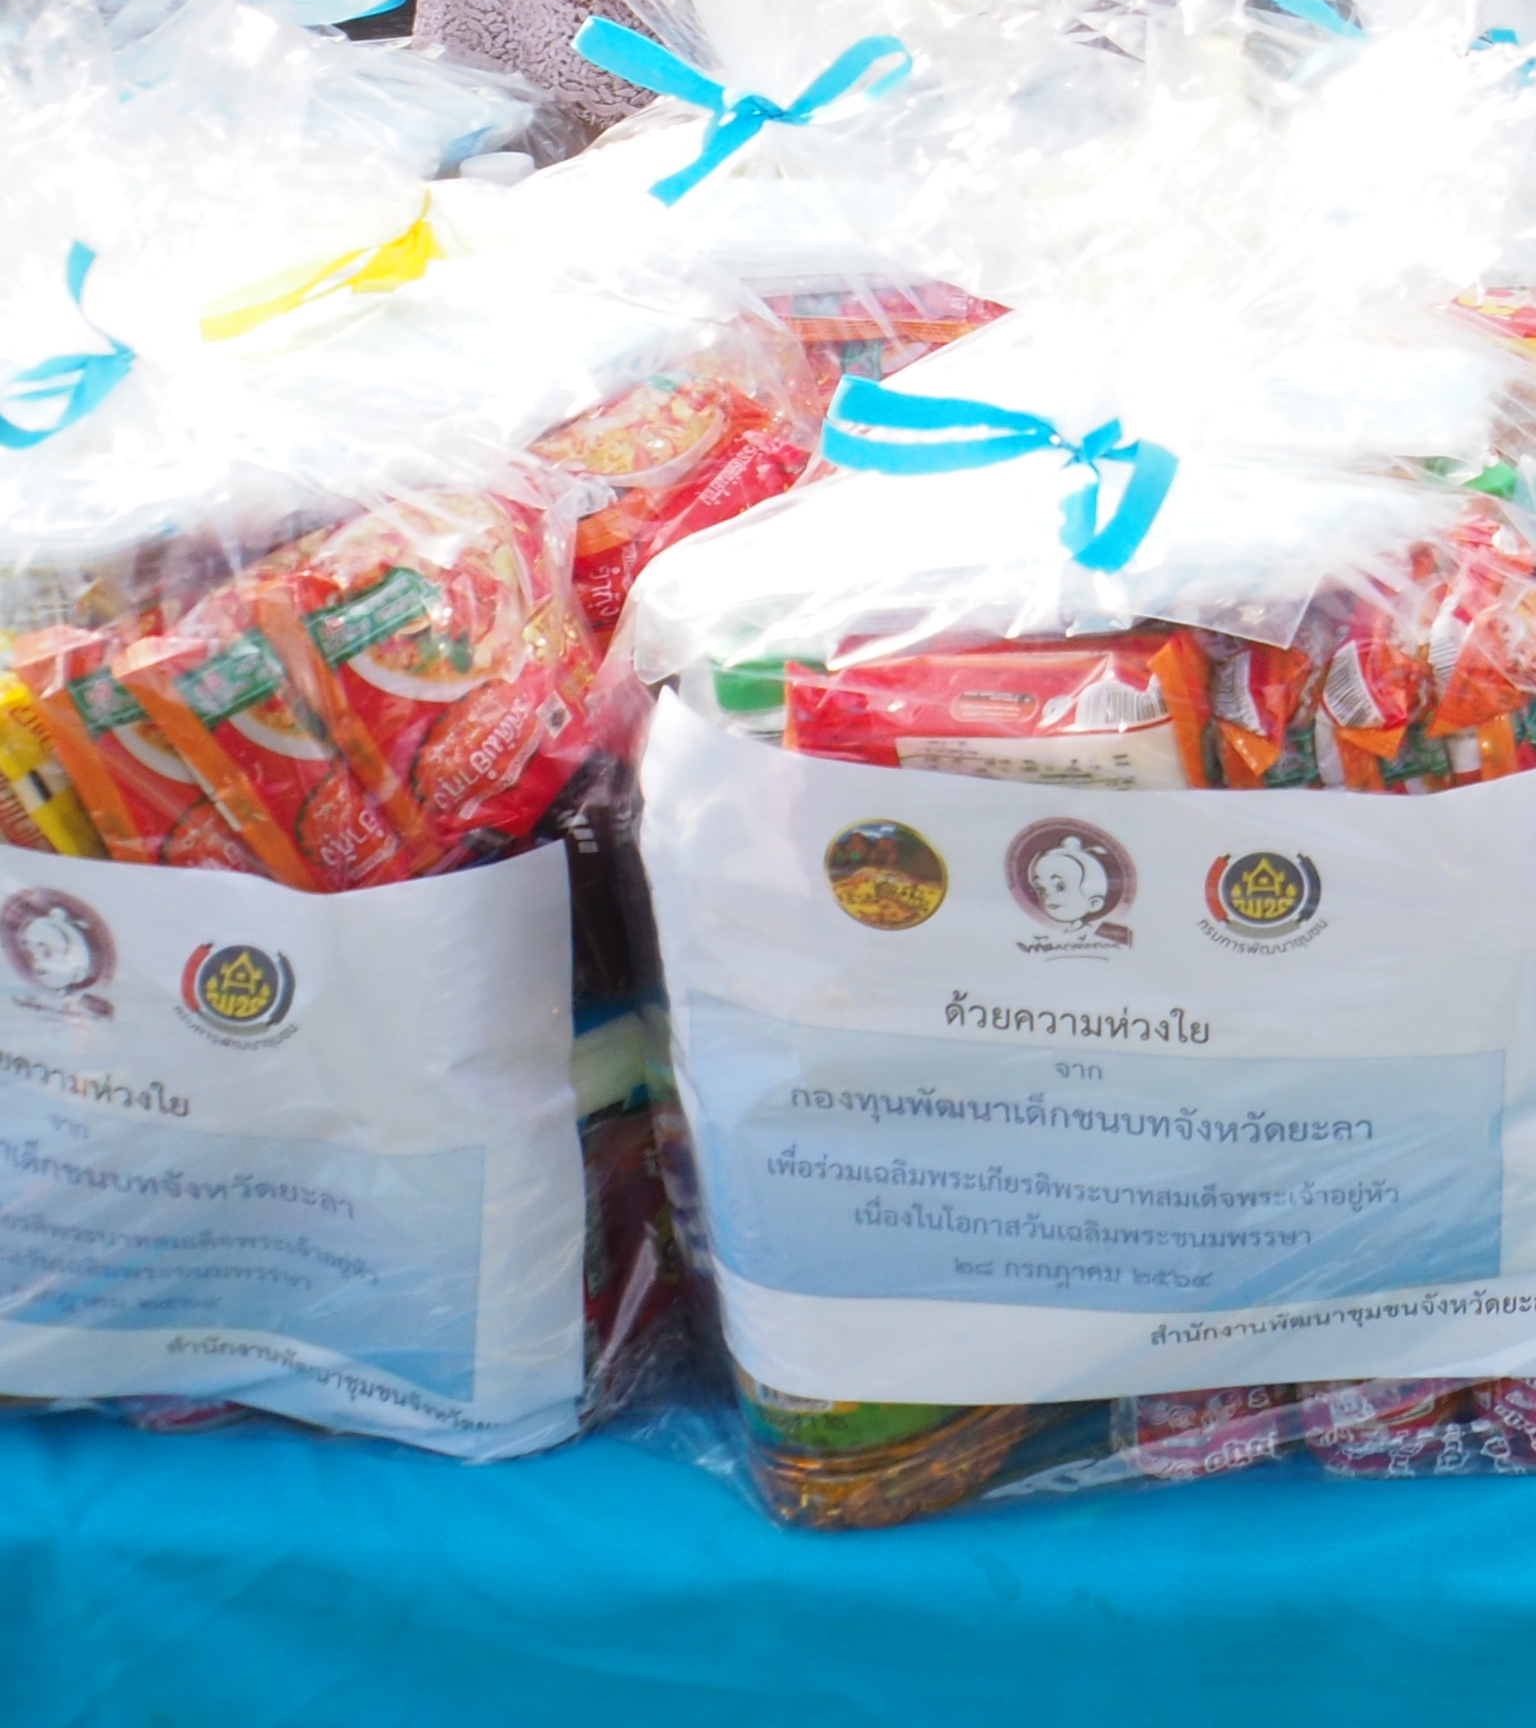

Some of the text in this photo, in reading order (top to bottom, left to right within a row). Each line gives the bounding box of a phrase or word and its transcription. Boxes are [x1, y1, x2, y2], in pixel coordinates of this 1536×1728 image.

[944, 989, 1211, 1046] ด้วยความห่วงใย
[1054, 1061, 1104, 1083] จาก
[789, 1084, 1375, 1144] กองทุนพัฒนาเด็กชนบทจังหวัดยะลา
[853, 1202, 1313, 1249] เนื่องในโอกาสวันเฉลิมพระชนมพรรษา
